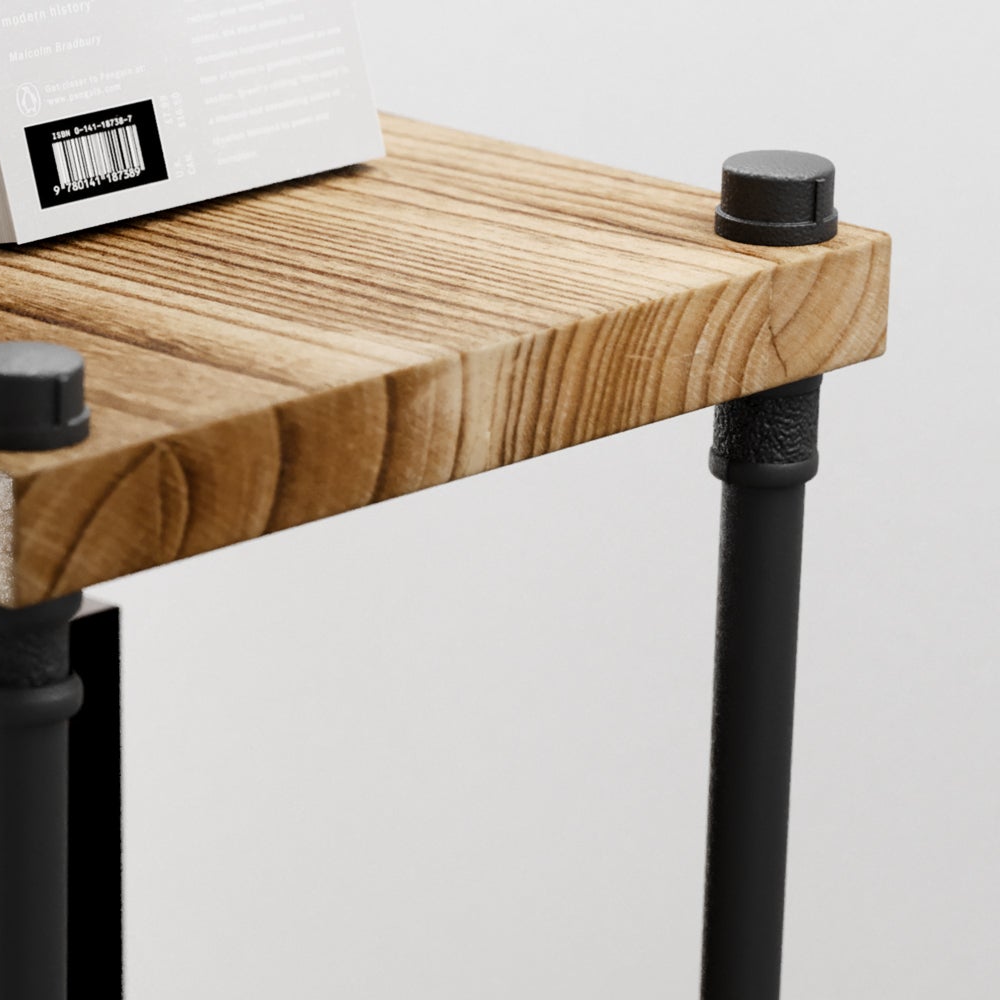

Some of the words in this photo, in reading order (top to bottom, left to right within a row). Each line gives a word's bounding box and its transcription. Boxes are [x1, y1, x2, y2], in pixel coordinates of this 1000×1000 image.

[0, 11, 47, 28] modern
[8, 44, 53, 63] Malcolm
[55, 33, 102, 54] Bradbury
[52, 129, 71, 141] ISBN
[74, 114, 133, 135] 0-141-18738-7
[53, 185, 61, 196] 9
[66, 175, 102, 193] 780141
[106, 167, 141, 184] 187389
